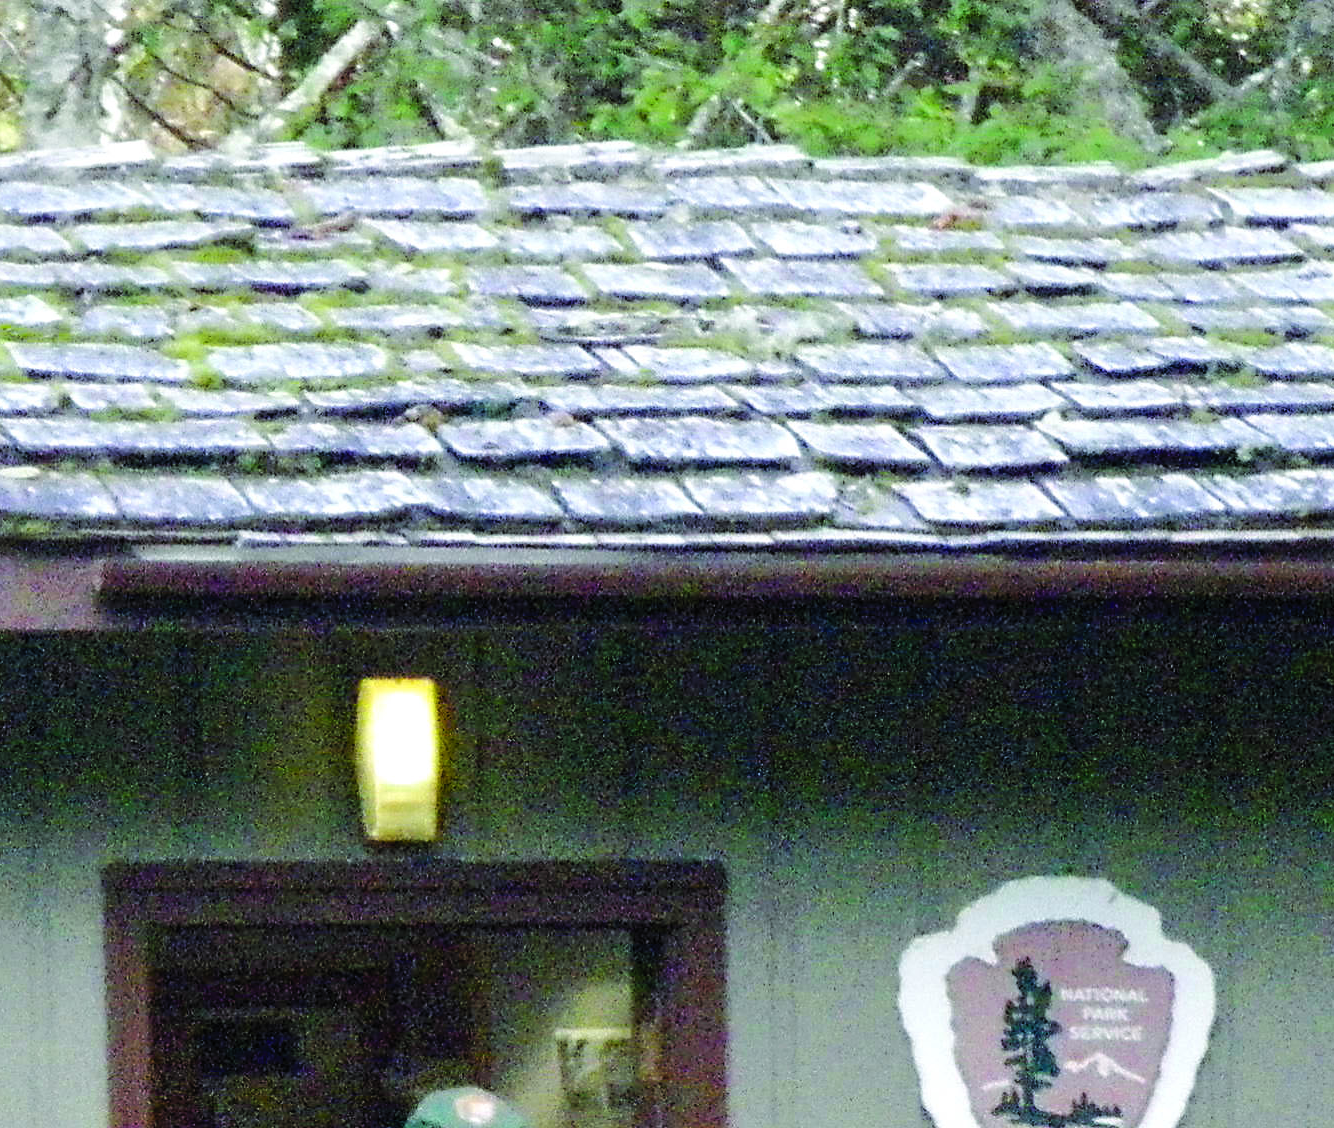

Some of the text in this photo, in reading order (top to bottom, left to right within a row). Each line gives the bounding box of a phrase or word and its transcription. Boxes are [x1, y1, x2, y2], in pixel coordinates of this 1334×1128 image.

[1060, 987, 1149, 1003] NATIONAL
[1082, 1007, 1129, 1022] PARK
[1069, 1026, 1144, 1042] SERVICE
